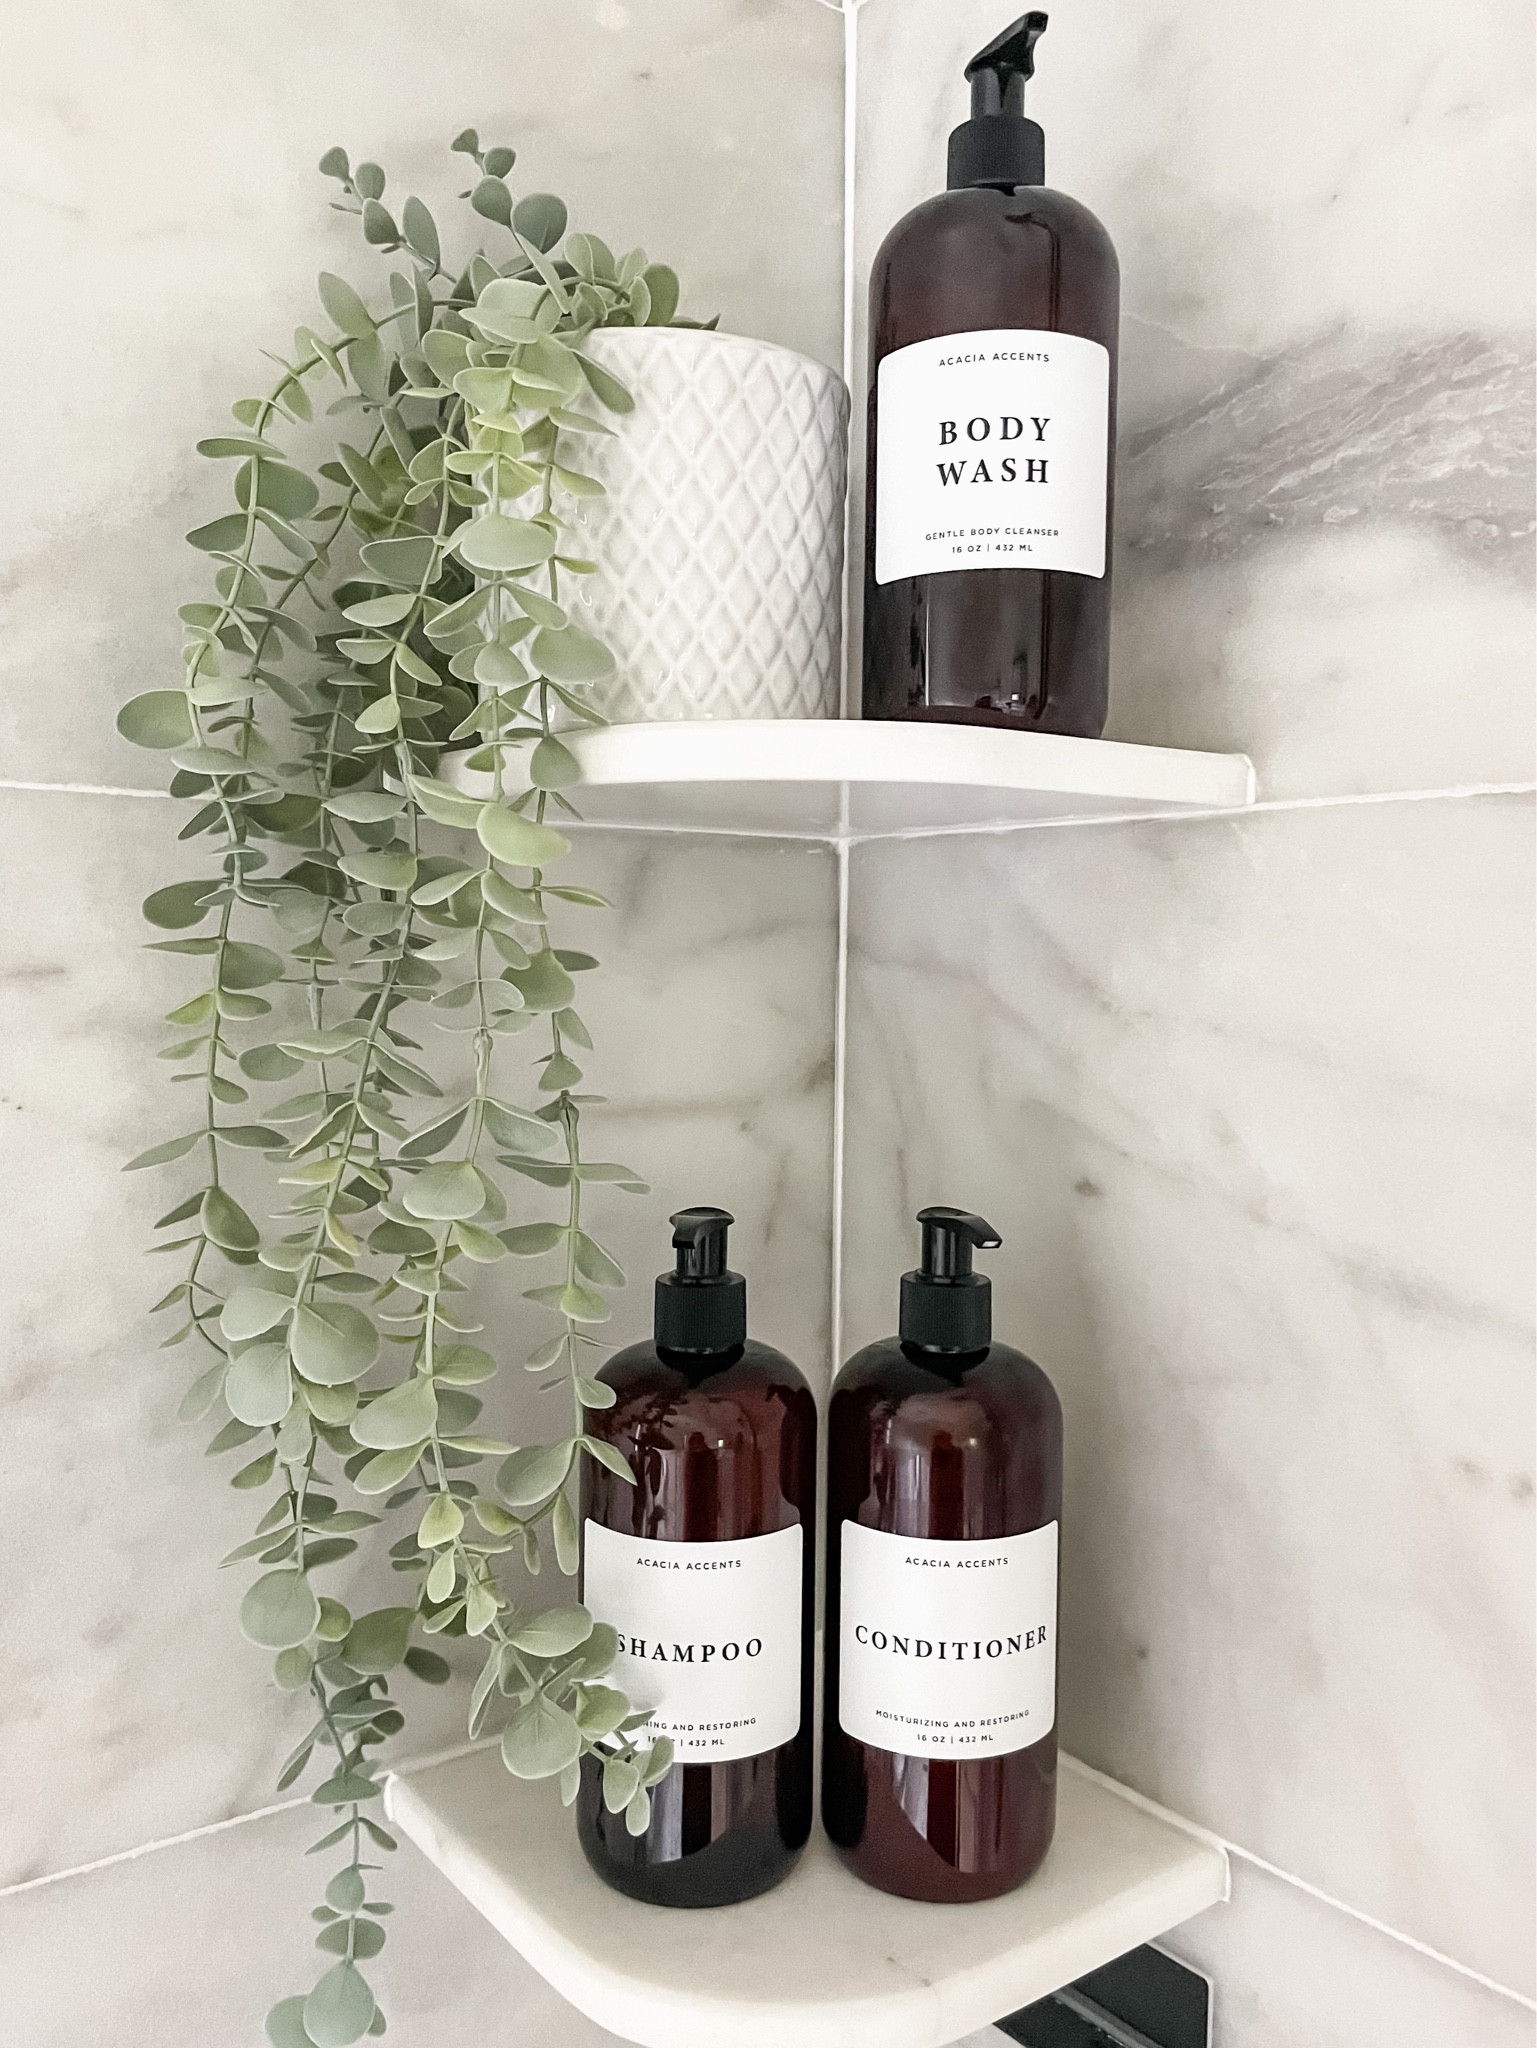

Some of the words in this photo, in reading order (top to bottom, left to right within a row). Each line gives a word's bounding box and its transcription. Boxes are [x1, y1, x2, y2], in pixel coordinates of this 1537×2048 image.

[939, 354, 986, 366] ACACIA
[993, 353, 1050, 362] ACCENTS
[939, 417, 1051, 446] BODY
[936, 458, 1048, 487] WASH
[925, 529, 965, 540] GENTLE
[971, 528, 1000, 536] BODY
[1005, 528, 1059, 536] CLEANSER
[637, 1558, 679, 1570] ACACIA
[686, 1560, 741, 1570] ACCENTS
[905, 1557, 950, 1568] ACACIA
[957, 1558, 1009, 1568] ACCENTS
[618, 1634, 762, 1662] SHAMPOO
[856, 1625, 1046, 1660] CONDITIONER
[672, 1723, 693, 1731] AND
[699, 1718, 756, 1731] RESTORING
[876, 1710, 949, 1728] MOISTURIZING
[954, 1720, 975, 1728] AND
[980, 1710, 1029, 1726] RESTORING
[917, 1734, 926, 1742] 16
[932, 1735, 945, 1743] OZ
